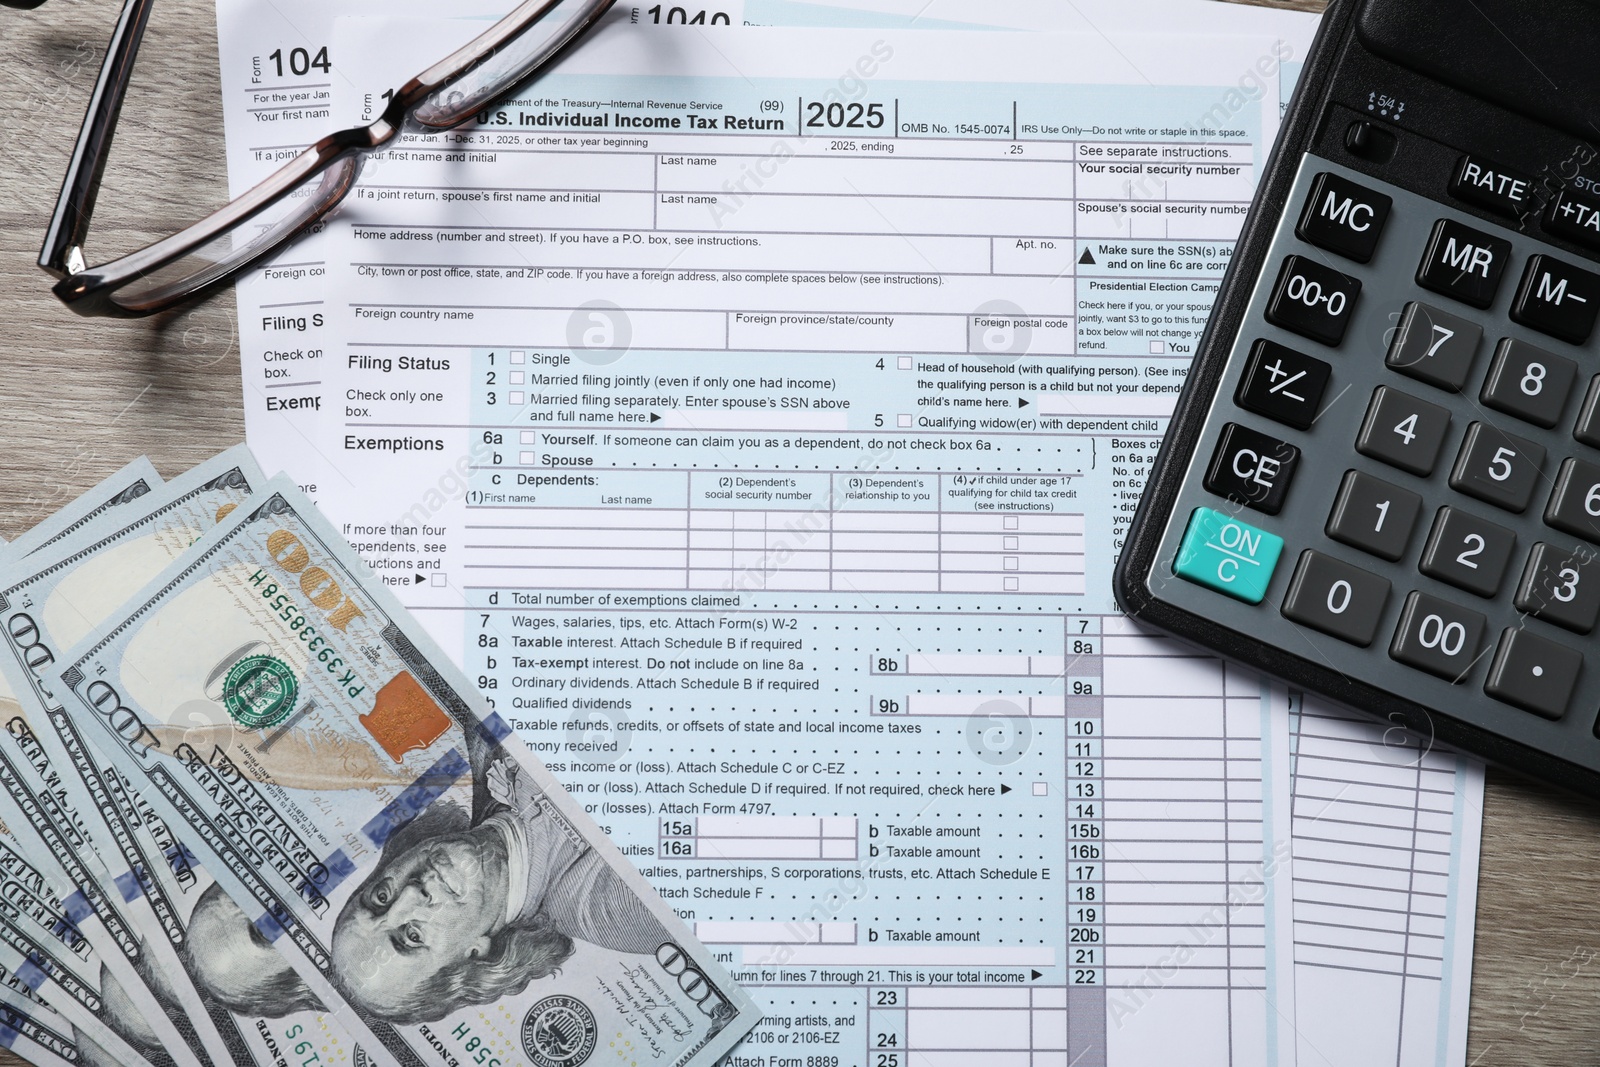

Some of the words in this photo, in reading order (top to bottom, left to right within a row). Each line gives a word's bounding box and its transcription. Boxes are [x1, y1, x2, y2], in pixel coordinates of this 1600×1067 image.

[250, 55, 262, 84] Form
[254, 94, 269, 102] For
[290, 93, 310, 102] year
[361, 92, 373, 122] Form
[760, 100, 784, 113] (99)
[254, 110, 279, 121] Your
[282, 111, 302, 119] first
[519, 113, 608, 128] Individual
[615, 114, 680, 128] Income
[687, 115, 718, 129] Tax
[724, 116, 783, 130] Return
[807, 103, 884, 128] 2025
[902, 123, 928, 132] OMB
[932, 124, 949, 133] No.
[955, 124, 1010, 134] 1545-0074
[1080, 145, 1103, 156] See
[1107, 148, 1158, 158] separate
[1162, 147, 1231, 157] instructions.
[661, 156, 683, 164] Last
[1079, 164, 1106, 173] Your
[1110, 164, 1142, 174] social
[1147, 165, 1190, 177] security
[1194, 166, 1240, 175] number
[1464, 163, 1526, 200] RATE
[358, 189, 364, 197] If
[378, 190, 399, 200] joint
[404, 192, 436, 201] return,
[441, 193, 489, 203] spouse's
[493, 192, 512, 201] first
[550, 193, 569, 202] and
[573, 194, 600, 202] initial
[662, 193, 684, 203] Last
[688, 194, 717, 204] name
[1078, 203, 1127, 213] Spouse's
[1131, 204, 1161, 213] social
[1165, 202, 1207, 215] security
[1321, 191, 1374, 232] MC
[1016, 239, 1038, 250] Apt.
[1041, 241, 1057, 249] no.
[1442, 237, 1493, 278] MR
[356, 308, 396, 320] Foreign
[400, 310, 440, 321] country
[737, 314, 776, 325] Foreign
[781, 315, 894, 327] province/state/county
[975, 318, 1010, 328] Foreign
[1013, 319, 1040, 330] postal
[1044, 320, 1068, 328] code
[1427, 325, 1455, 358] 7
[349, 356, 392, 372] Filing
[398, 357, 450, 370] Status
[532, 354, 570, 367] Single
[532, 374, 578, 385] Married
[582, 375, 610, 388] filing
[614, 375, 650, 388] jointly
[654, 376, 688, 388] (even
[693, 376, 700, 386] if
[704, 377, 728, 390] only
[733, 379, 755, 387] one
[760, 378, 782, 388] had
[787, 378, 835, 391] income)
[1520, 362, 1547, 396] 8
[346, 389, 386, 400] Check
[390, 391, 416, 403] only
[420, 393, 443, 401] one
[346, 406, 371, 416] box.
[1394, 414, 1416, 445] 4
[345, 436, 444, 452] Exemptions
[542, 434, 597, 445] Yourself.
[540, 454, 593, 468] Spouse
[1488, 447, 1517, 481] 5
[1232, 448, 1281, 489] CE
[518, 474, 598, 486] Dependents:
[1375, 500, 1391, 532] 1
[1219, 523, 1262, 557] ON
[1456, 534, 1486, 569] 2
[1217, 558, 1239, 583] C
[266, 529, 367, 634] 100
[1553, 568, 1580, 603] 3
[1326, 580, 1353, 615] 0
[512, 616, 558, 630] Wages,
[564, 617, 614, 628] salaries,
[620, 617, 644, 630] tips,
[650, 618, 671, 628] etc.
[675, 618, 714, 628] Attach
[720, 618, 768, 631] Form(s)
[772, 618, 797, 629] W-2
[1418, 614, 1467, 656] 00
[512, 697, 568, 708] Qualified
[572, 698, 631, 709] dividends
[87, 680, 161, 759] 100
[508, 719, 557, 730] Taxable
[562, 720, 612, 731] refunds,
[617, 720, 661, 731] credits,
[667, 723, 679, 731] or
[683, 720, 724, 731] offsets
[728, 721, 740, 732] of
[744, 722, 774, 732] state
[779, 722, 801, 732] and
[806, 722, 834, 732] local
[839, 722, 884, 733] income
[888, 723, 921, 733] taxes
[660, 803, 698, 814] Attach
[704, 803, 735, 814] Form
[541, 799, 584, 846] FRANKLIN
[664, 822, 691, 835] 15a
[887, 825, 932, 836] Taxable
[936, 827, 980, 836] amount
[1071, 824, 1100, 838] 15b
[663, 841, 691, 854] 16a
[886, 846, 932, 857] Taxable
[936, 848, 980, 857] amount
[1071, 845, 1099, 858] 16b
[886, 930, 931, 941] Taxable
[936, 932, 980, 941] amount
[1071, 928, 1099, 942] 20b
[656, 941, 724, 1018] 100
[1075, 970, 1095, 984] 22
